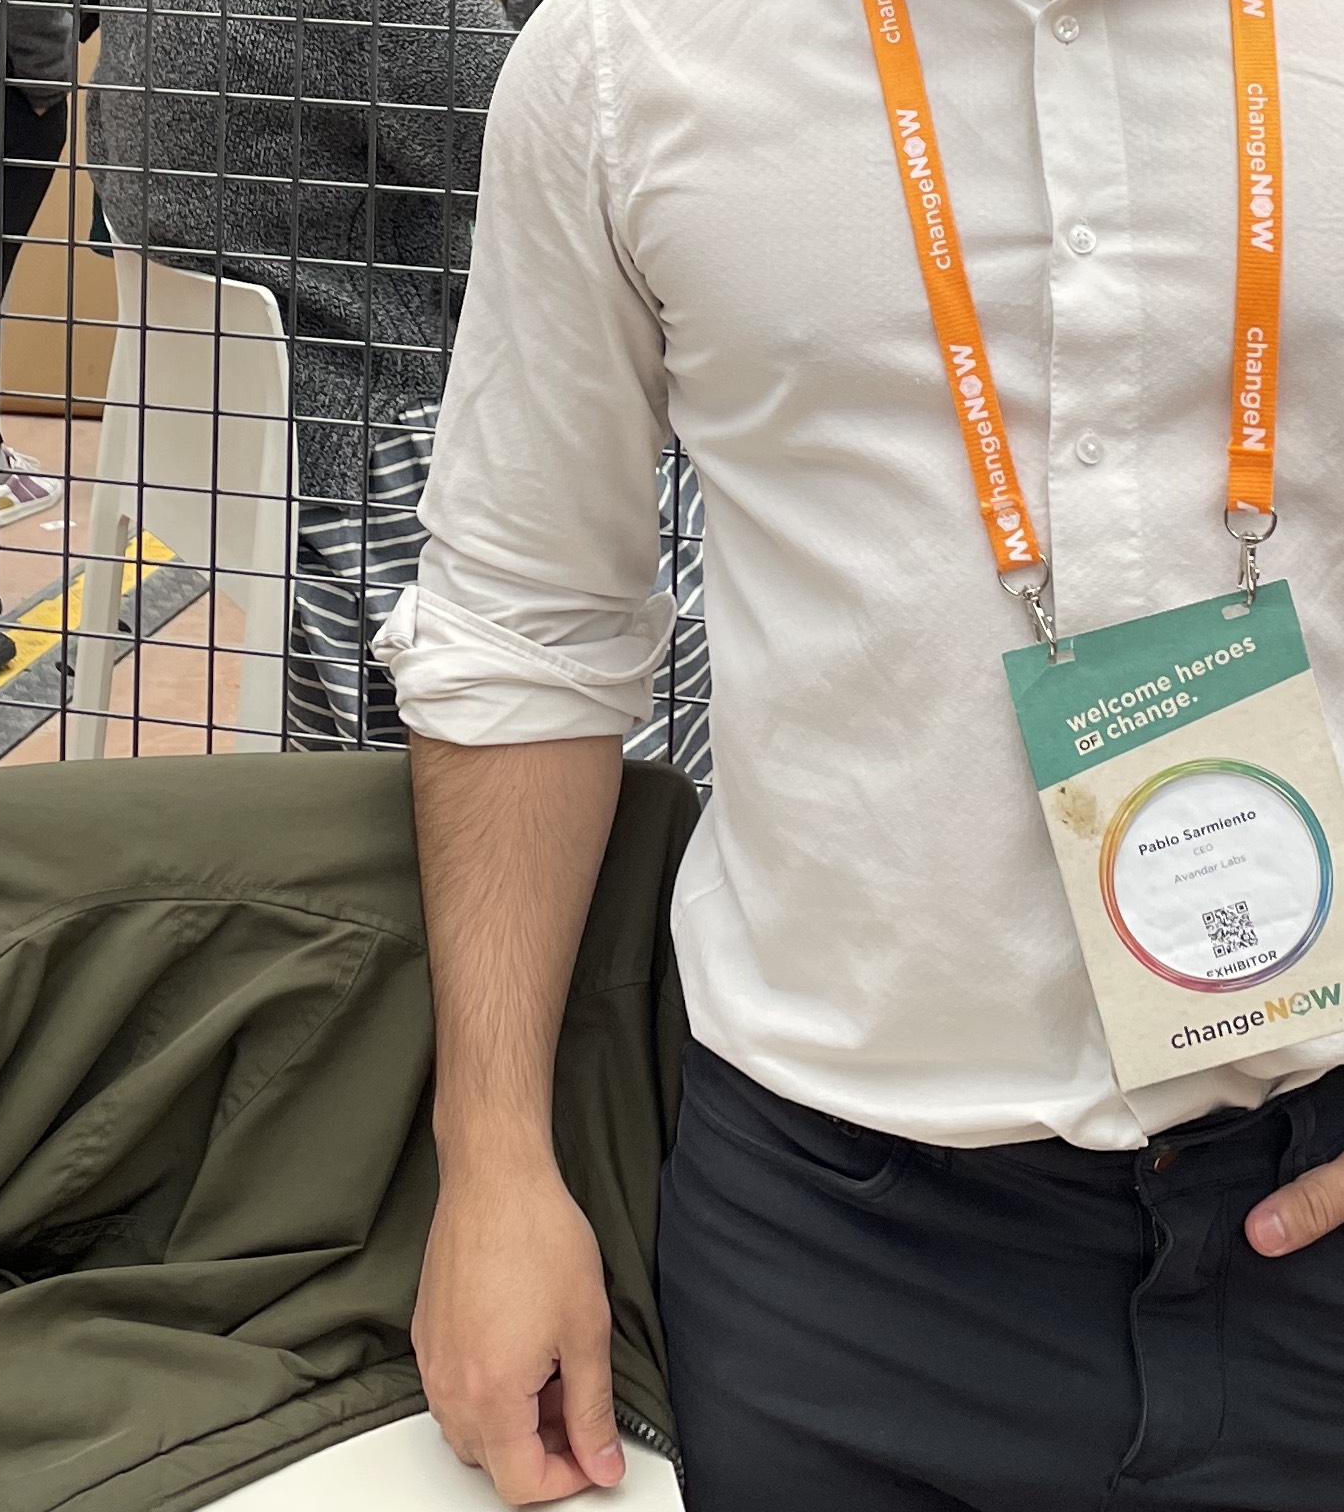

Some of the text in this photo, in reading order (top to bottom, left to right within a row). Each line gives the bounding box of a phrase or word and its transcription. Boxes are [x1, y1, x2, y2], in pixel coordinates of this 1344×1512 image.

[895, 108, 952, 271] changeNOW
[1245, 83, 1275, 254] changeNOW
[1239, 326, 1269, 451] changeN
[1065, 636, 1257, 733] welcome heroes
[1078, 691, 1199, 752] OF change.
[1138, 810, 1257, 856] Pablo Sarmiento
[1192, 842, 1215, 857] CEO
[1173, 854, 1248, 884] Avandar Labs
[1206, 950, 1278, 978] EXHIBITOR
[1171, 982, 1341, 1050] changeNOW
